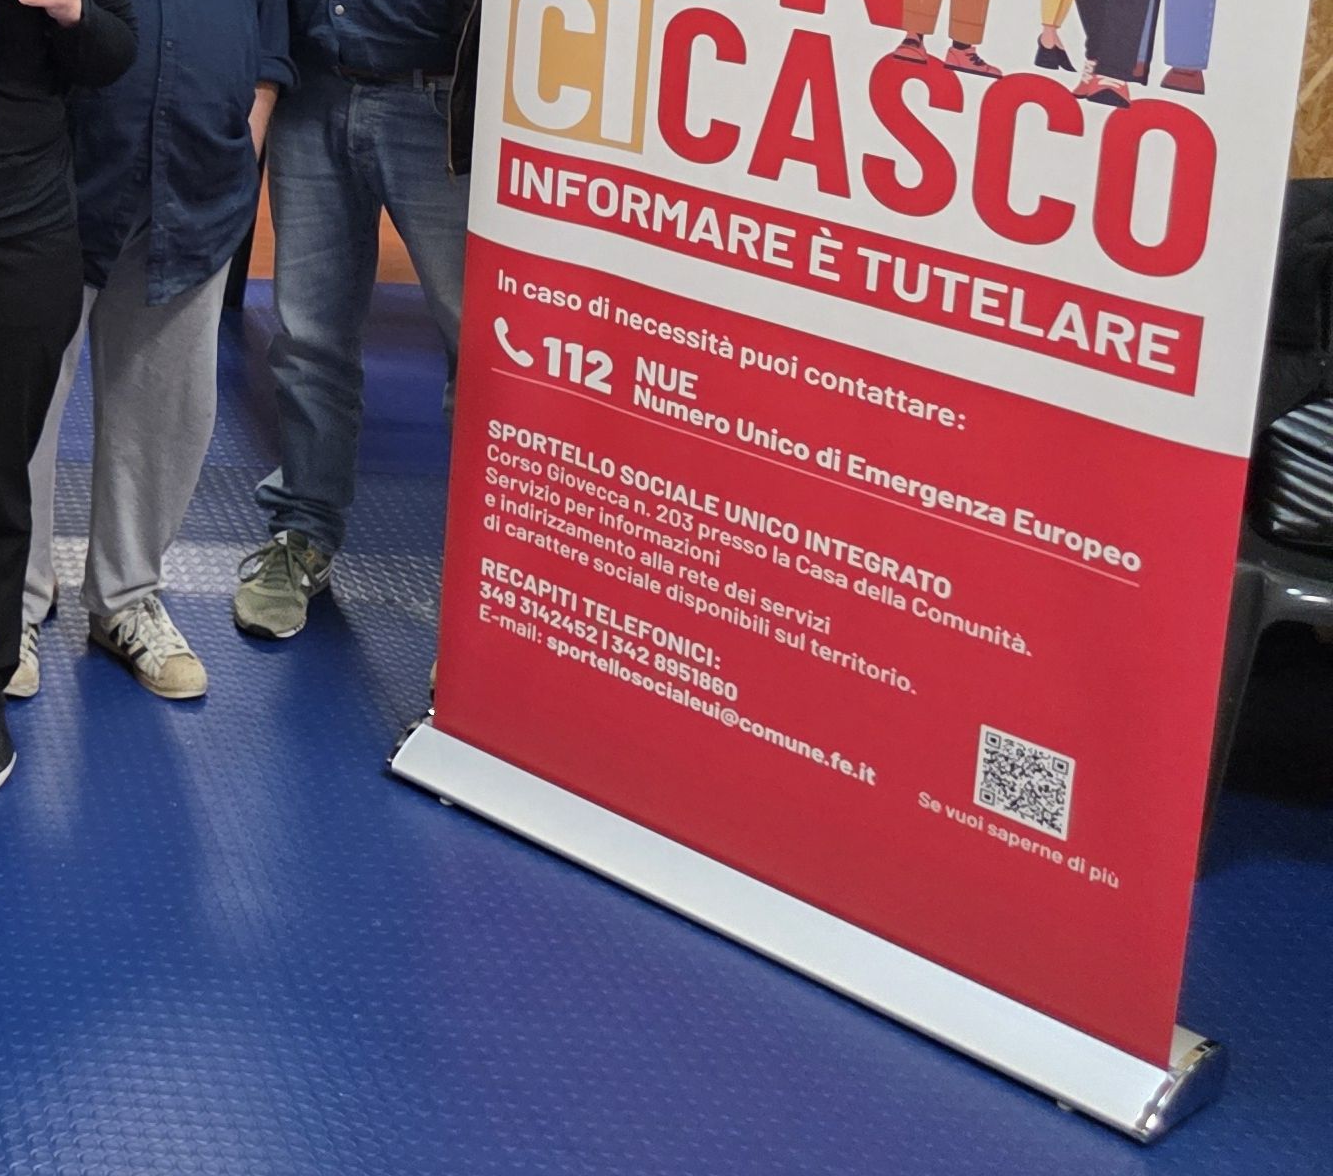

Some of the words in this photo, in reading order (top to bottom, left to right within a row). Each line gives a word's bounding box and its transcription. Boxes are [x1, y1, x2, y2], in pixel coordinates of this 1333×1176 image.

[657, 7, 1218, 277] CASCO
[509, 157, 796, 271] INFORMARE
[808, 218, 844, 282] È
[856, 246, 1181, 375] TUTELARE
[497, 269, 518, 295] In
[522, 282, 582, 311] caso
[588, 295, 610, 320] di
[614, 306, 734, 360] necessità
[739, 346, 799, 380] puoi
[804, 366, 966, 431] contattare:
[542, 336, 614, 395] 112
[635, 356, 699, 400] NUE
[485, 466, 561, 506] Servizio
[564, 497, 596, 520] per
[598, 506, 721, 568] informazioni
[487, 443, 543, 476] Corso
[546, 462, 630, 510] Giovecca
[633, 499, 651, 518] n.
[655, 503, 694, 532] 203
[697, 522, 768, 559] presso
[772, 545, 791, 569] la
[795, 554, 849, 590] Casa
[852, 577, 907, 611] della
[911, 596, 1031, 657] Comunità.
[488, 419, 616, 479] SPORTELLO
[619, 464, 720, 517] SOCIALE
[724, 500, 800, 545] UNICO
[804, 529, 952, 600] INTEGRATO
[633, 383, 731, 435] Numero
[736, 417, 811, 461] Unico
[815, 446, 842, 473] di
[846, 453, 1007, 526] Emergenza
[1011, 507, 1142, 572] Europeo
[479, 580, 516, 609] 349
[519, 595, 598, 645] 3142452
[610, 634, 650, 666] 342
[653, 652, 738, 702] 8951860
[481, 557, 578, 612] RECAPITI
[581, 596, 721, 670] TELEFONICI:
[483, 513, 501, 532] di
[504, 523, 590, 566] carattere
[593, 557, 662, 595] sociale
[665, 583, 771, 637] disponibili
[774, 627, 806, 651] sul
[810, 638, 916, 694] territorio.
[484, 493, 496, 508] e
[500, 493, 636, 560] indirizzamento
[639, 551, 675, 576] alla
[678, 565, 720, 592] rete
[723, 581, 756, 606] dei
[760, 596, 831, 635] servizi
[479, 603, 542, 644] E-mail:
[546, 635, 877, 786] sportellosocialeui@comune.fe.it
[918, 791, 942, 813] Se
[945, 805, 984, 831] vuoi
[987, 823, 1064, 864] saperne
[1067, 855, 1086, 874] di
[1089, 866, 1119, 889] più
